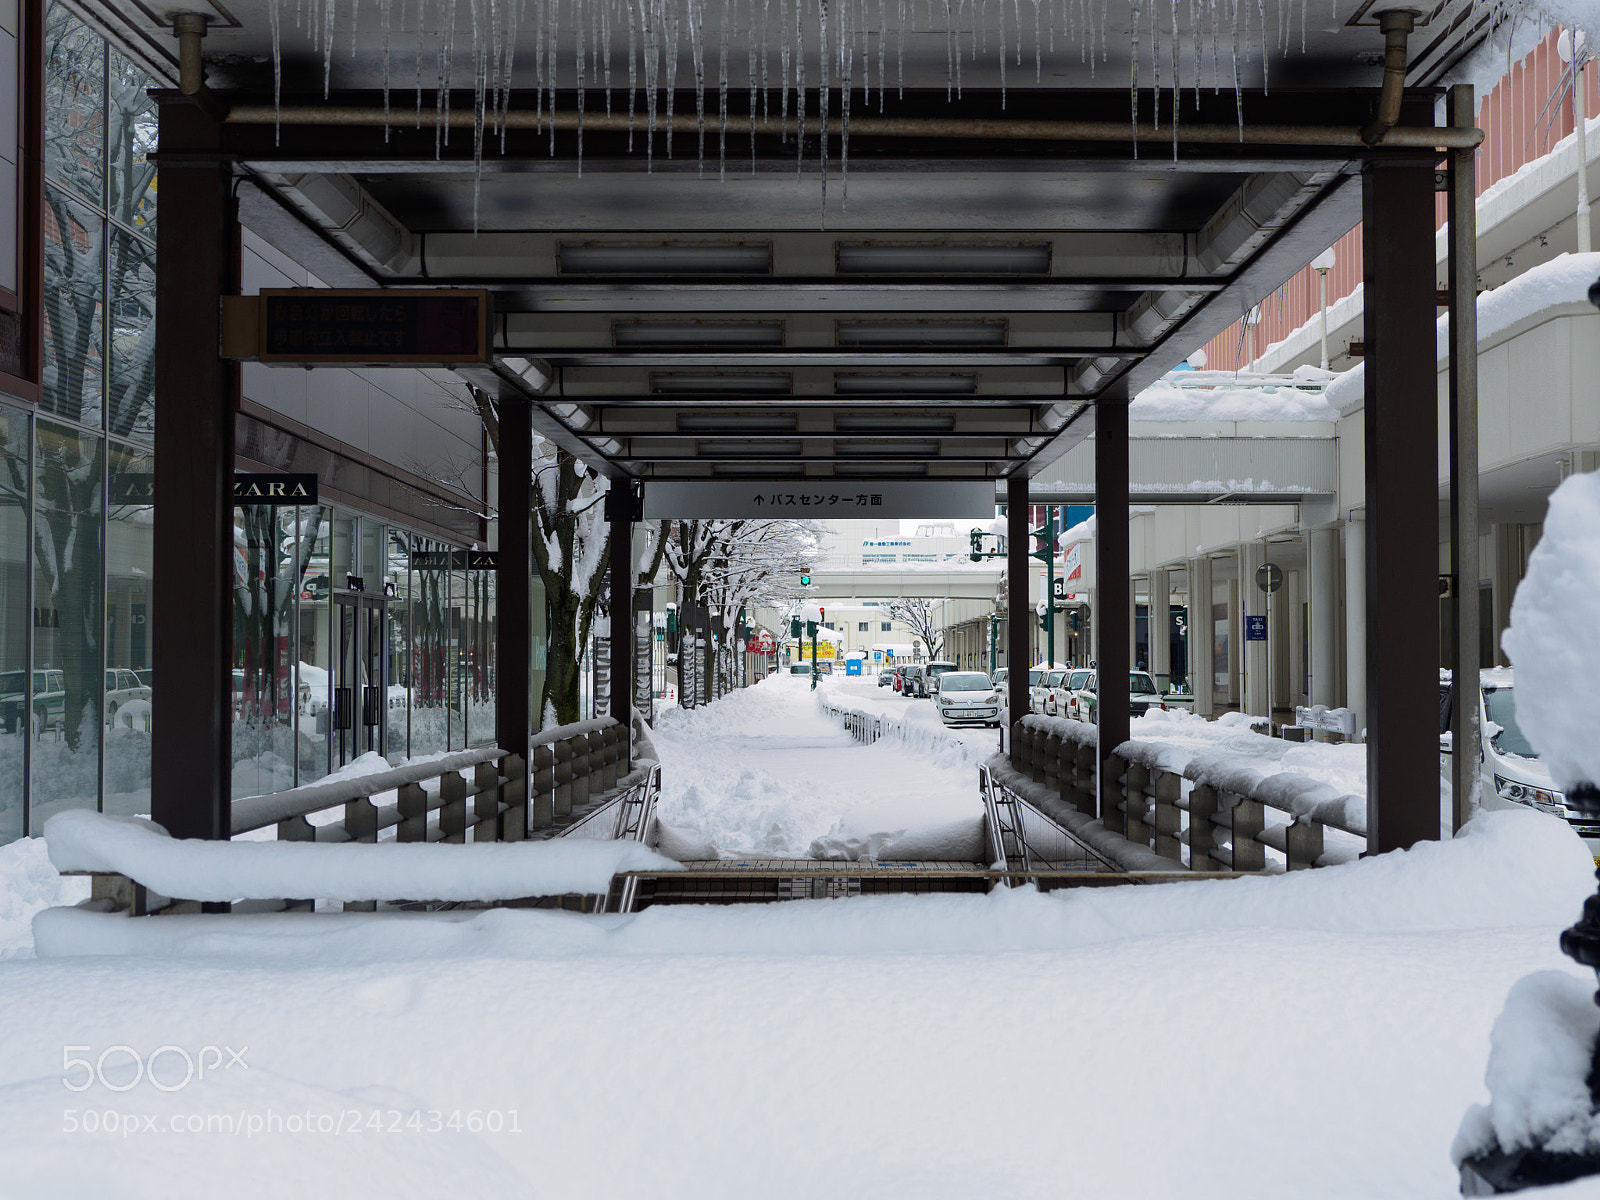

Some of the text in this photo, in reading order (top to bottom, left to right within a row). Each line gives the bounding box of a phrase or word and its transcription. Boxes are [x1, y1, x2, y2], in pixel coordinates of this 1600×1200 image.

[770, 494, 883, 506] バスセンター方面
[472, 556, 496, 566] ZA
